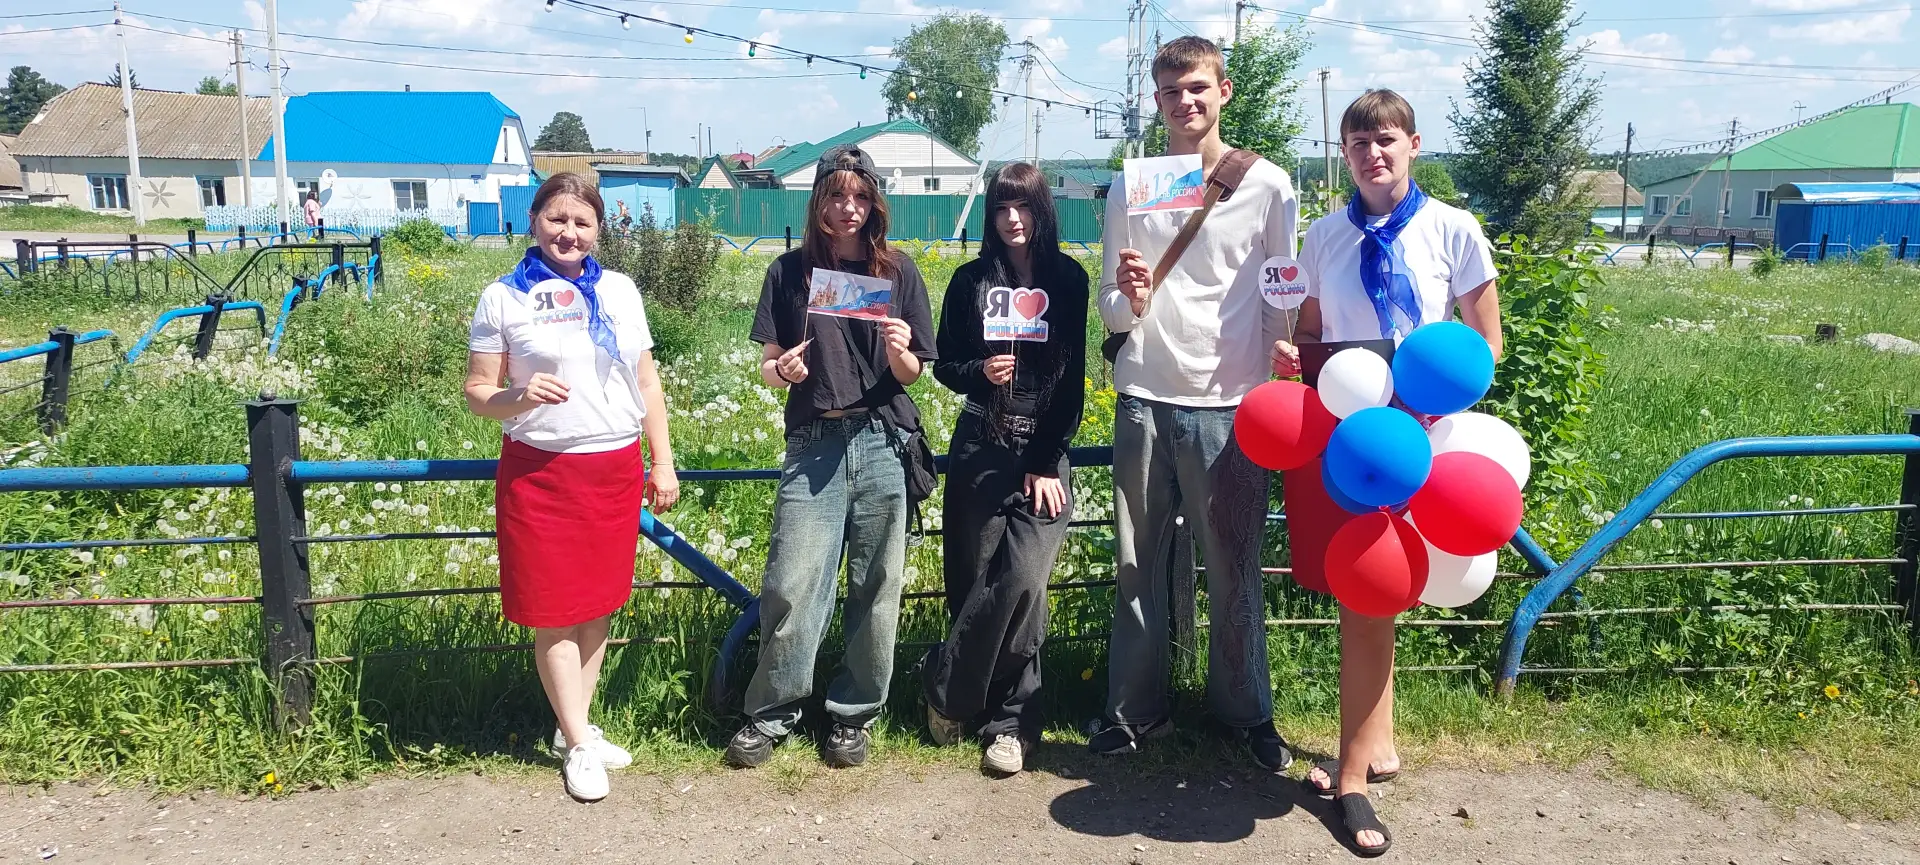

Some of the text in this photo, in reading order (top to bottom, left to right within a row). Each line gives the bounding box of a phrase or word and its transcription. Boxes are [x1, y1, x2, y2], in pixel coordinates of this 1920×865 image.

[1152, 171, 1176, 197] 12
[1171, 187, 1197, 198] РОССИИ!
[1264, 266, 1281, 284] Я
[1263, 283, 1306, 296] РОССИЮ
[533, 291, 555, 312] Я
[987, 289, 1010, 318] Я
[532, 308, 583, 326] РОССИЮ
[986, 321, 1046, 339] РОССИЮ
